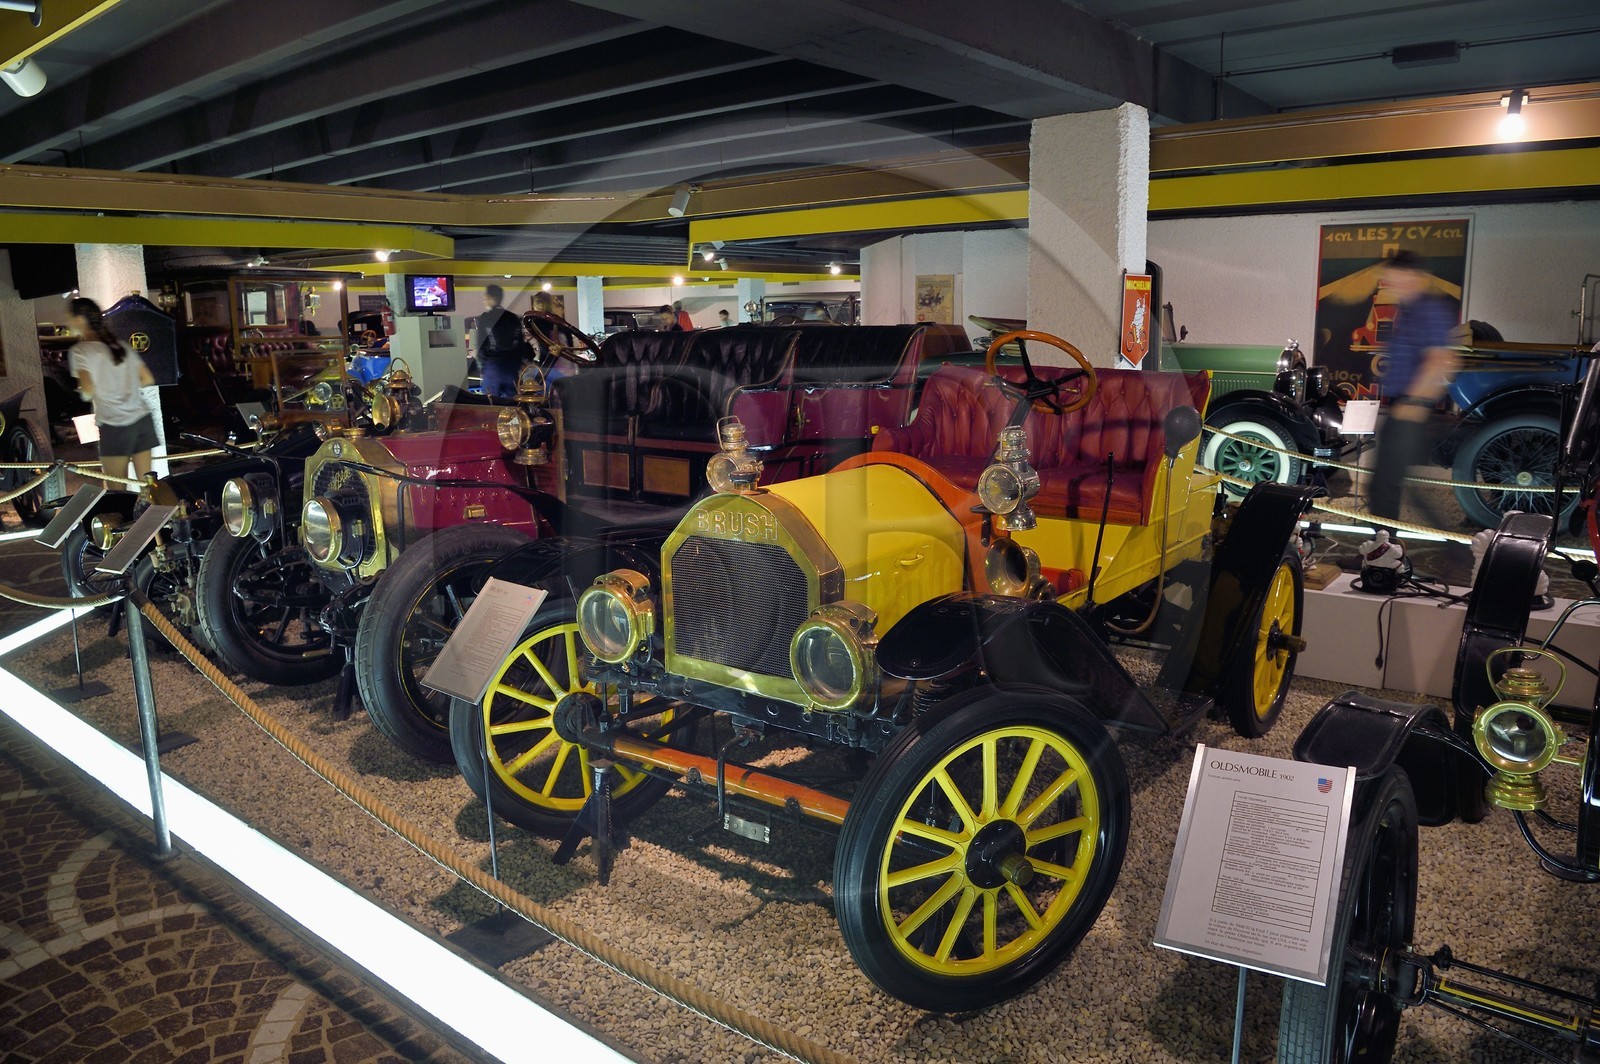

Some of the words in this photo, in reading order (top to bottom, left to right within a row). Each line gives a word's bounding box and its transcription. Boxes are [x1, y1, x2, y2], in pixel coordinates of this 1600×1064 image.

[1358, 228, 1388, 240] LES
[1392, 227, 1404, 240] 7
[1406, 226, 1432, 239] CV
[1126, 280, 1151, 290] MICHELIN
[696, 509, 778, 541] BRUSH
[1210, 760, 1277, 778] OLDSMOBILE
[1279, 773, 1295, 781] 1902
